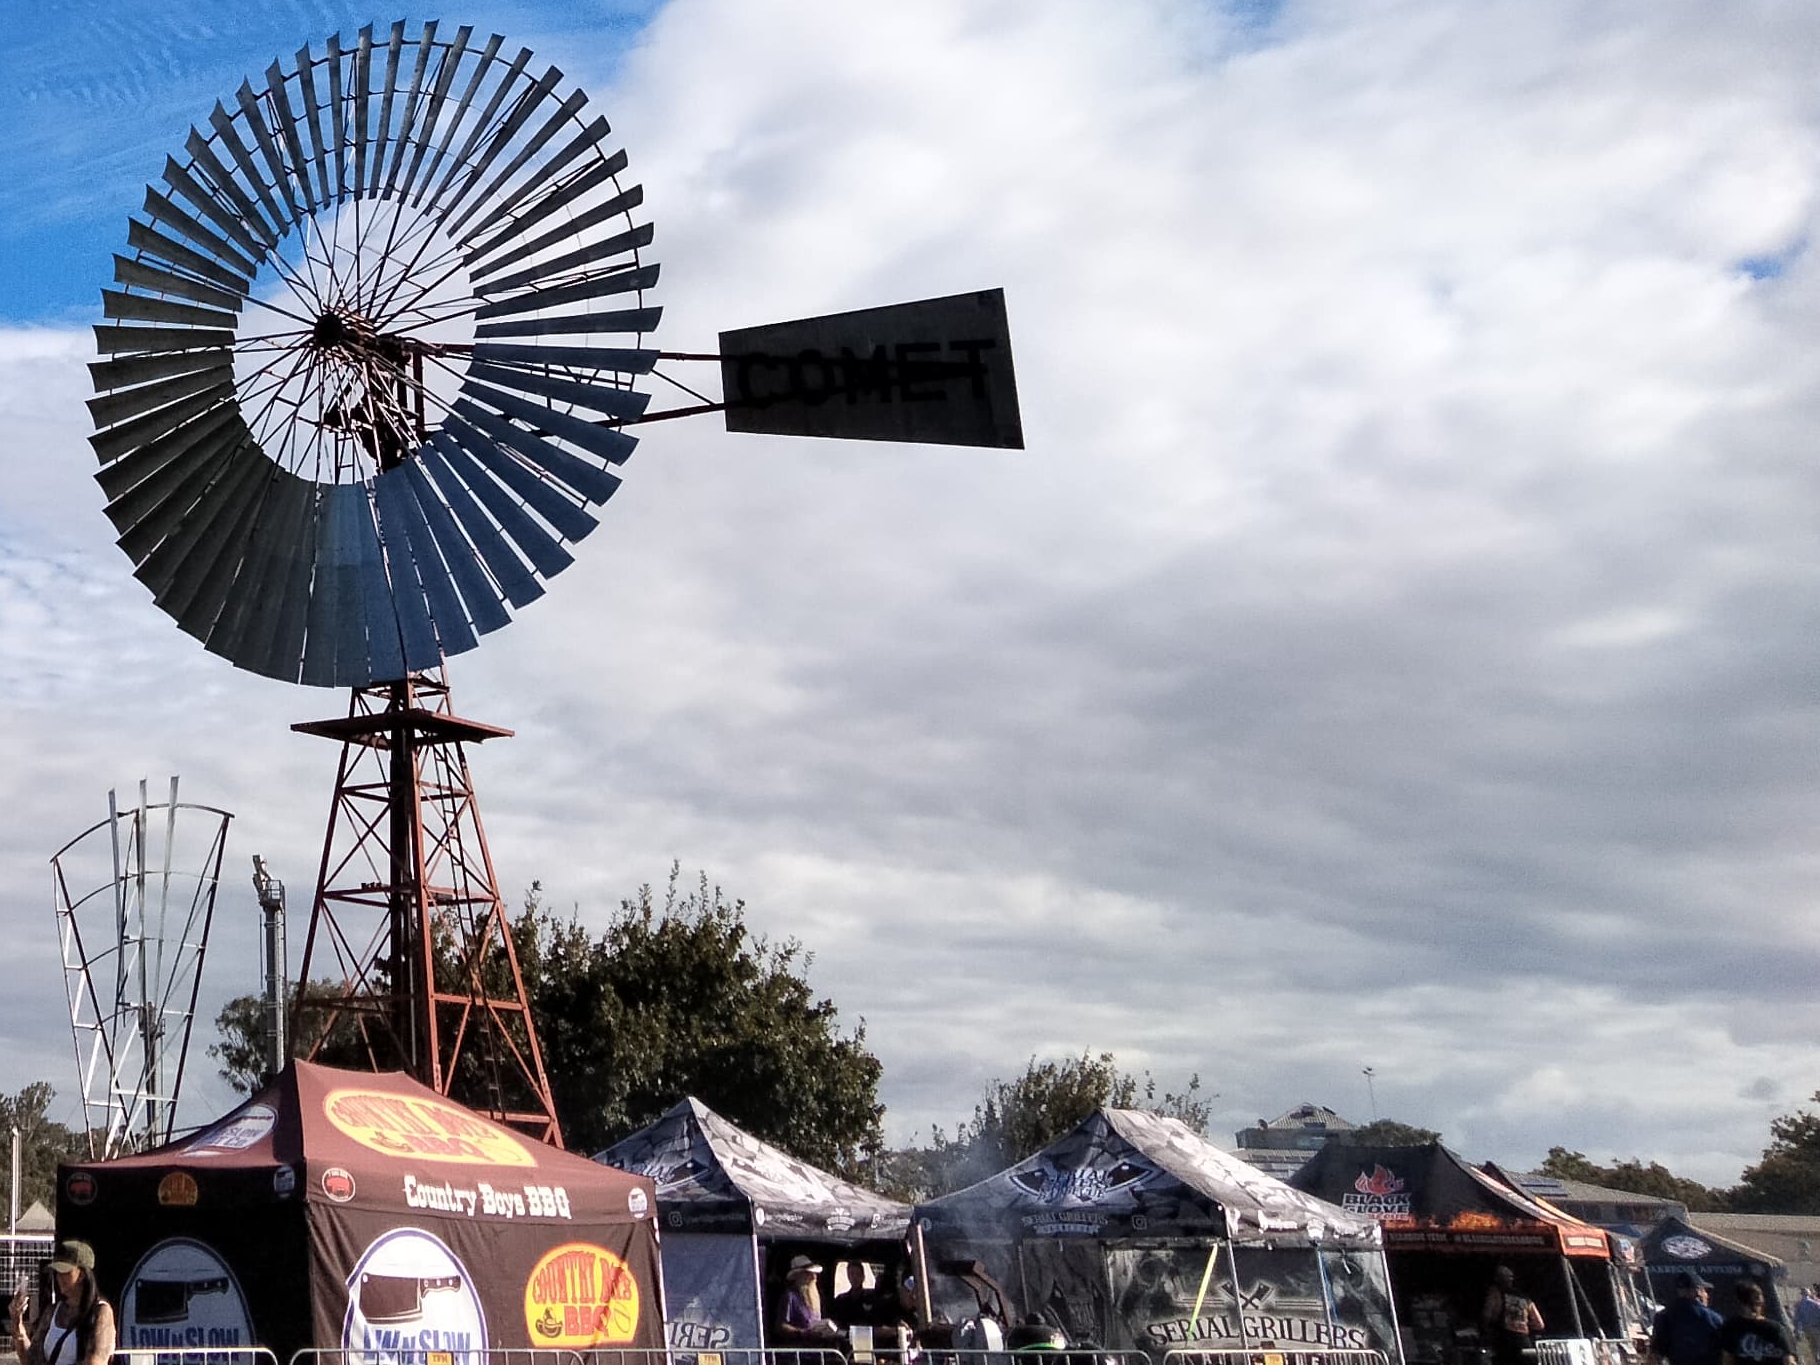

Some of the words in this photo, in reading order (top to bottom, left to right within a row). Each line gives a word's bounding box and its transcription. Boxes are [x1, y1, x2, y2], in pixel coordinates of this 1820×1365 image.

[737, 338, 996, 409] COMET
[402, 1175, 477, 1217] Country
[478, 1183, 526, 1219] Boys
[524, 1185, 572, 1220] BBQ
[1343, 1194, 1411, 1204] BLACK
[532, 1251, 596, 1304] COUNTRY
[564, 1306, 609, 1337] BBQ
[1147, 1315, 1239, 1347] SERIAL
[1242, 1315, 1366, 1349] GRILLERS
